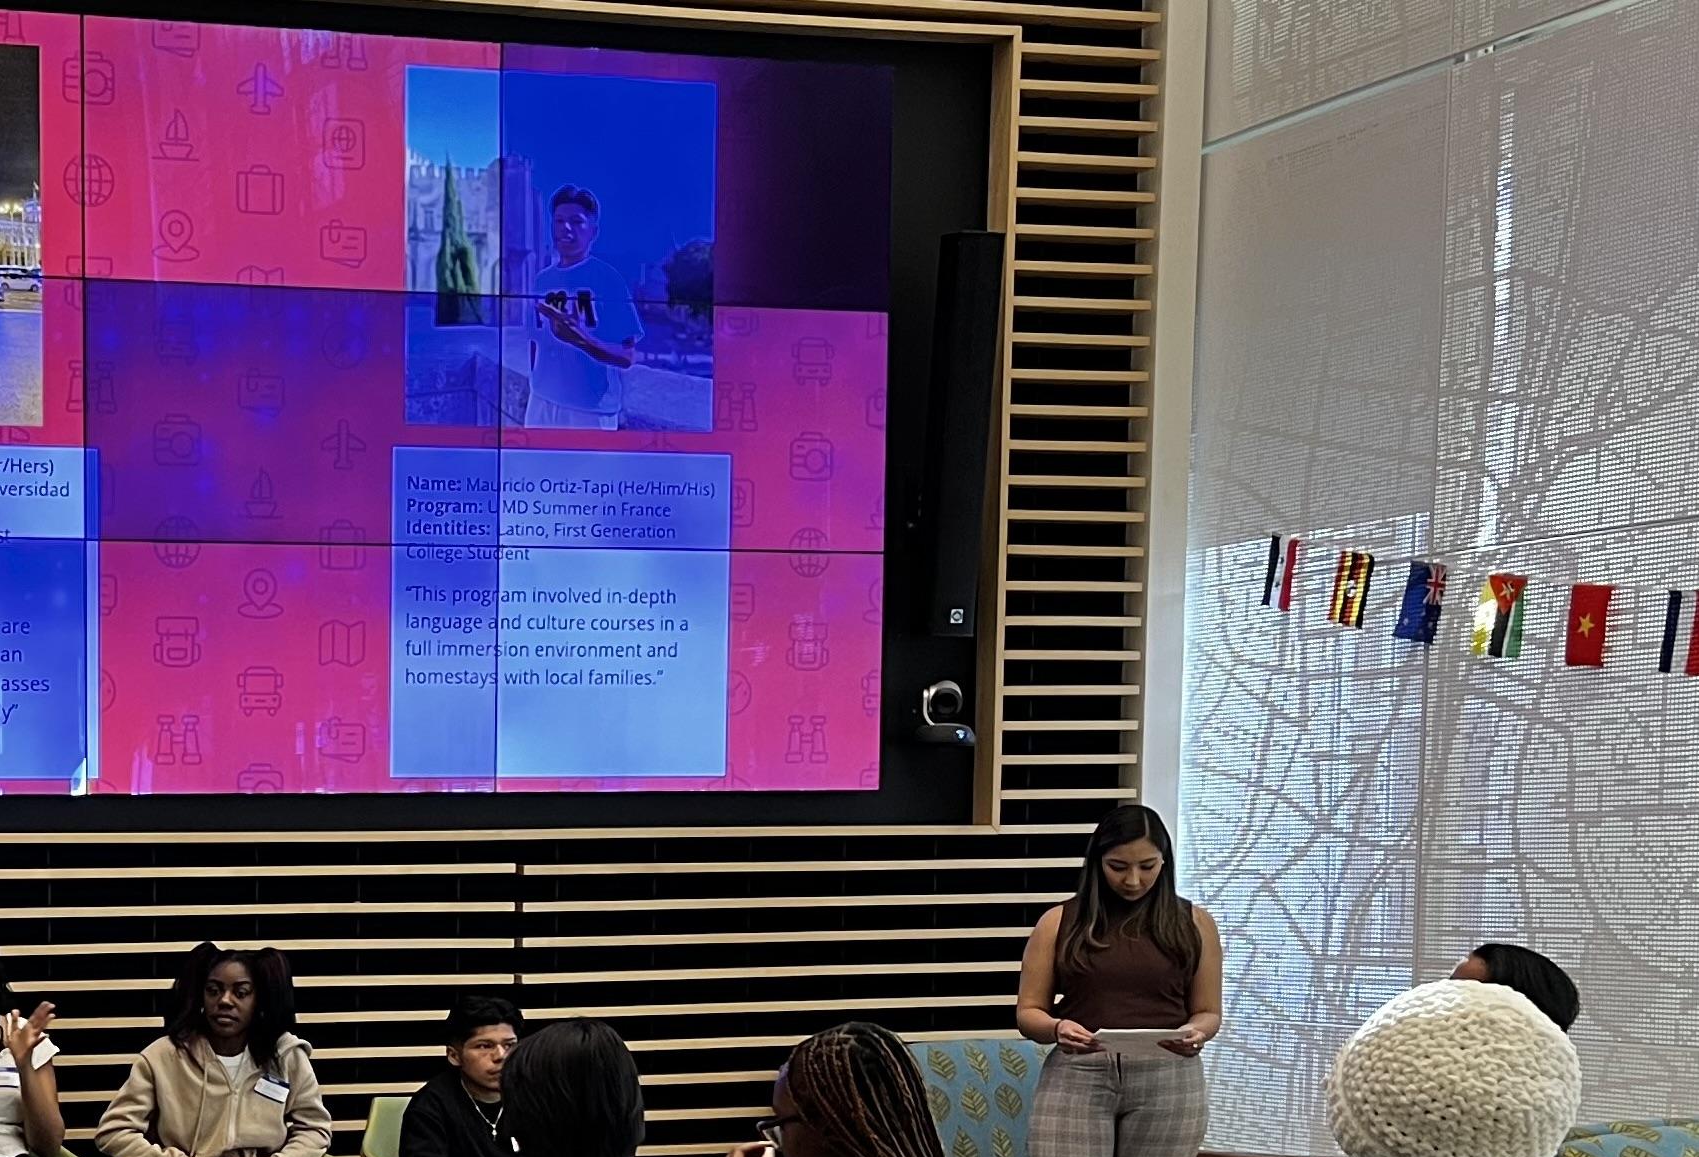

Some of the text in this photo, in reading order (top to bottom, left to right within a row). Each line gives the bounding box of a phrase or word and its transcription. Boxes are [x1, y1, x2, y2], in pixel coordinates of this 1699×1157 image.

[407, 476, 715, 498] Name: Mauricio Ortiz-Tapi (He/Him/His)
[407, 499, 482, 516] Program:
[533, 501, 597, 516] Summer
[603, 502, 615, 516] in
[621, 503, 671, 518] France
[407, 521, 490, 535] Identities:
[554, 523, 586, 538] First
[591, 524, 675, 539] Generation
[407, 545, 529, 563] College Student
[452, 588, 526, 606] program
[533, 588, 601, 604] involved
[607, 589, 676, 609] in-depth
[2, 621, 30, 635] are
[406, 614, 688, 633] language and culture courses in a
[406, 640, 678, 658] full immersion environment and
[2, 679, 50, 692] asses
[406, 669, 496, 688] homestays
[505, 670, 539, 686] with
[545, 669, 583, 686] local
